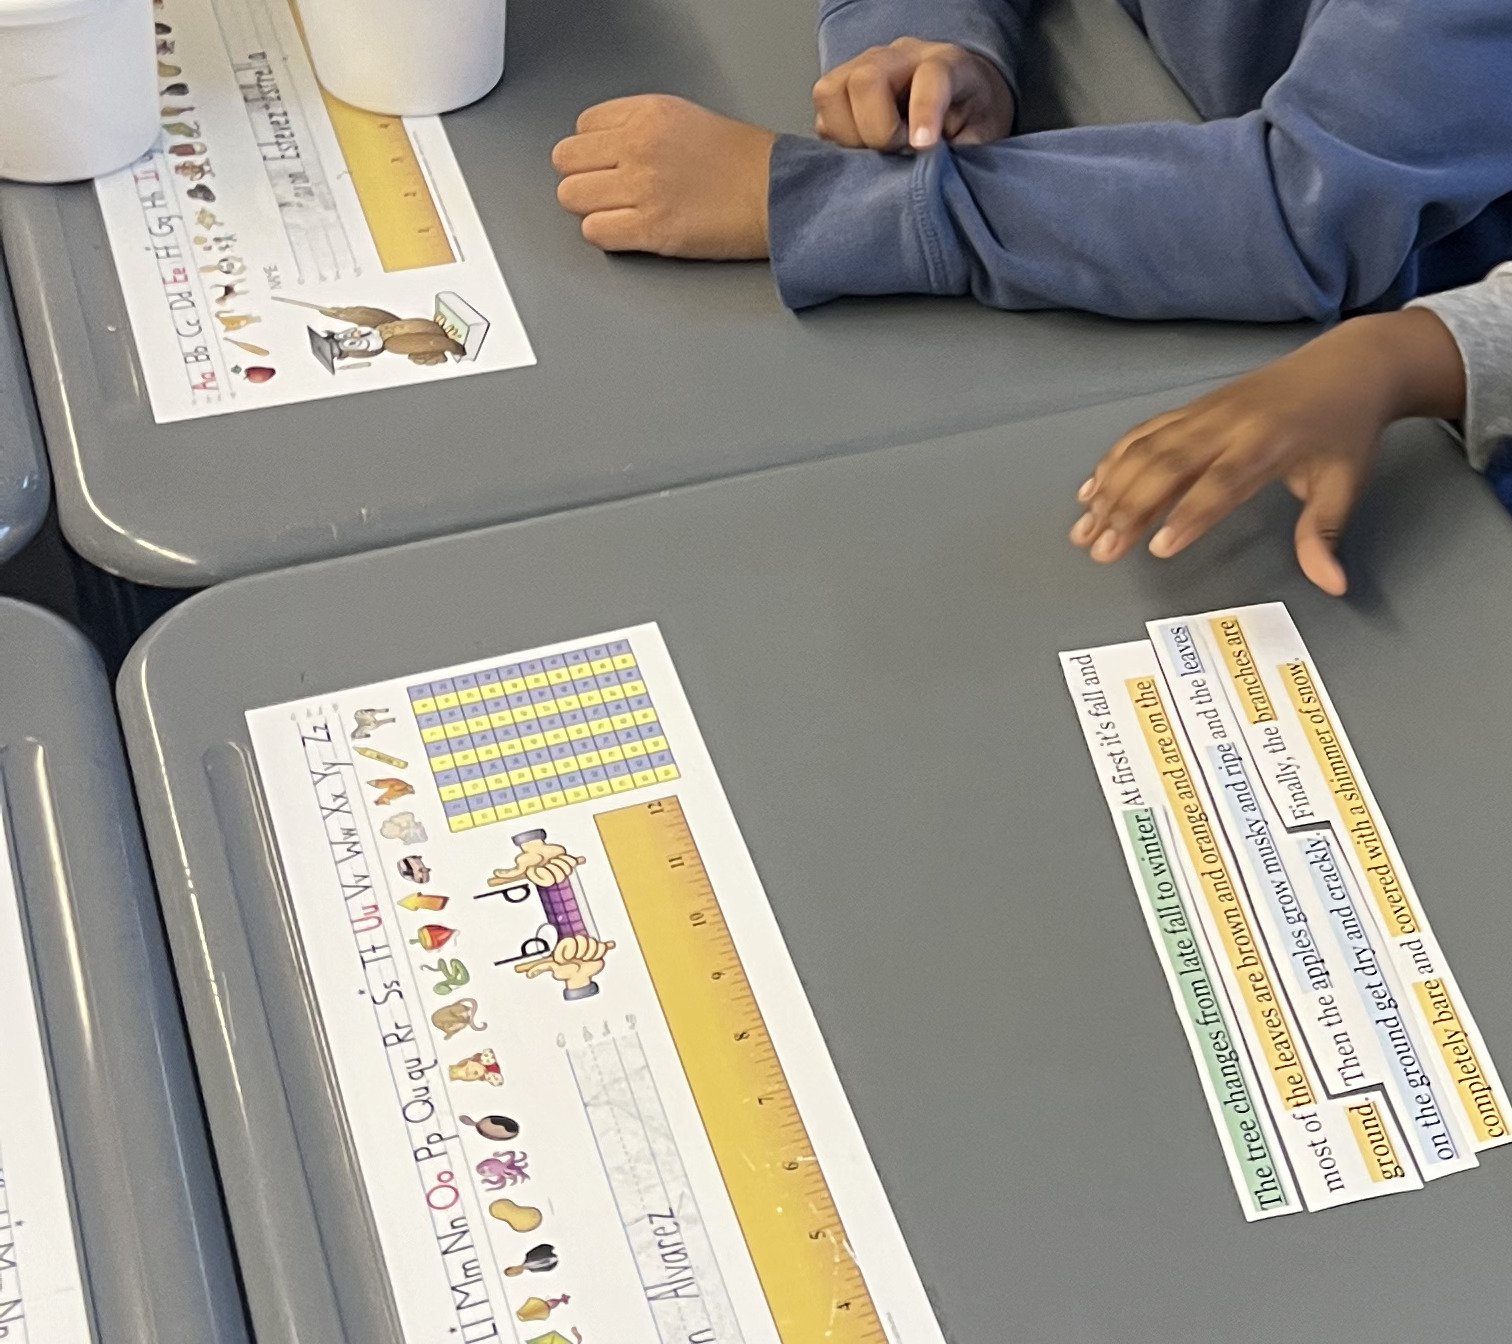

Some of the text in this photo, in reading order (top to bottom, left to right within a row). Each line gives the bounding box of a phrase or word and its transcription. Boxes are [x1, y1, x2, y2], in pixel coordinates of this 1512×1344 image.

[1070, 654, 1100, 686] and
[1082, 690, 1111, 717] fall
[1220, 619, 1315, 820] Finally, the branches are
[302, 723, 331, 747] Zz
[311, 761, 354, 785] Yy
[1107, 752, 1136, 785] first
[320, 791, 353, 821] Xx
[647, 801, 665, 815] 12
[1121, 789, 1145, 806] At
[330, 827, 363, 864] Ww
[1135, 808, 1167, 877] winter.
[1171, 625, 1366, 1087] Then the apples grow musky and ripe and the leaves
[668, 856, 685, 869] 11
[341, 874, 372, 900] Vv
[1157, 881, 1175, 900] to
[1286, 657, 1505, 1138] completely bare and covered with a shimmer of snow.
[351, 904, 383, 934] Uu
[689, 912, 707, 927] 10
[1157, 904, 1187, 934] fall
[1135, 680, 1345, 1193] most of the leaves are brown and orange and are on the
[359, 944, 393, 970] Tt
[1177, 939, 1202, 976] late
[711, 971, 726, 980] 9
[371, 980, 403, 1005] Ss
[1191, 978, 1221, 1027] from
[1305, 832, 1454, 1161] on the ground get dry and crackly.
[383, 1022, 416, 1047] Rr
[733, 1031, 750, 1042] 8
[1209, 1030, 1239, 1114] changes
[757, 1097, 774, 1106] 7
[413, 1132, 459, 1162] Pp
[1240, 1121, 1267, 1161] tree
[1349, 1096, 1405, 1180] ground.
[782, 1162, 799, 1171] 6
[426, 1170, 459, 1210] Oo
[1254, 1167, 1283, 1210] The
[437, 1216, 474, 1256] Nn
[809, 1230, 827, 1240] 5
[644, 1207, 700, 1302] Alvarez
[451, 1258, 490, 1311] Mm
[837, 1301, 852, 1311] 4
[461, 1316, 498, 1344] Ll
